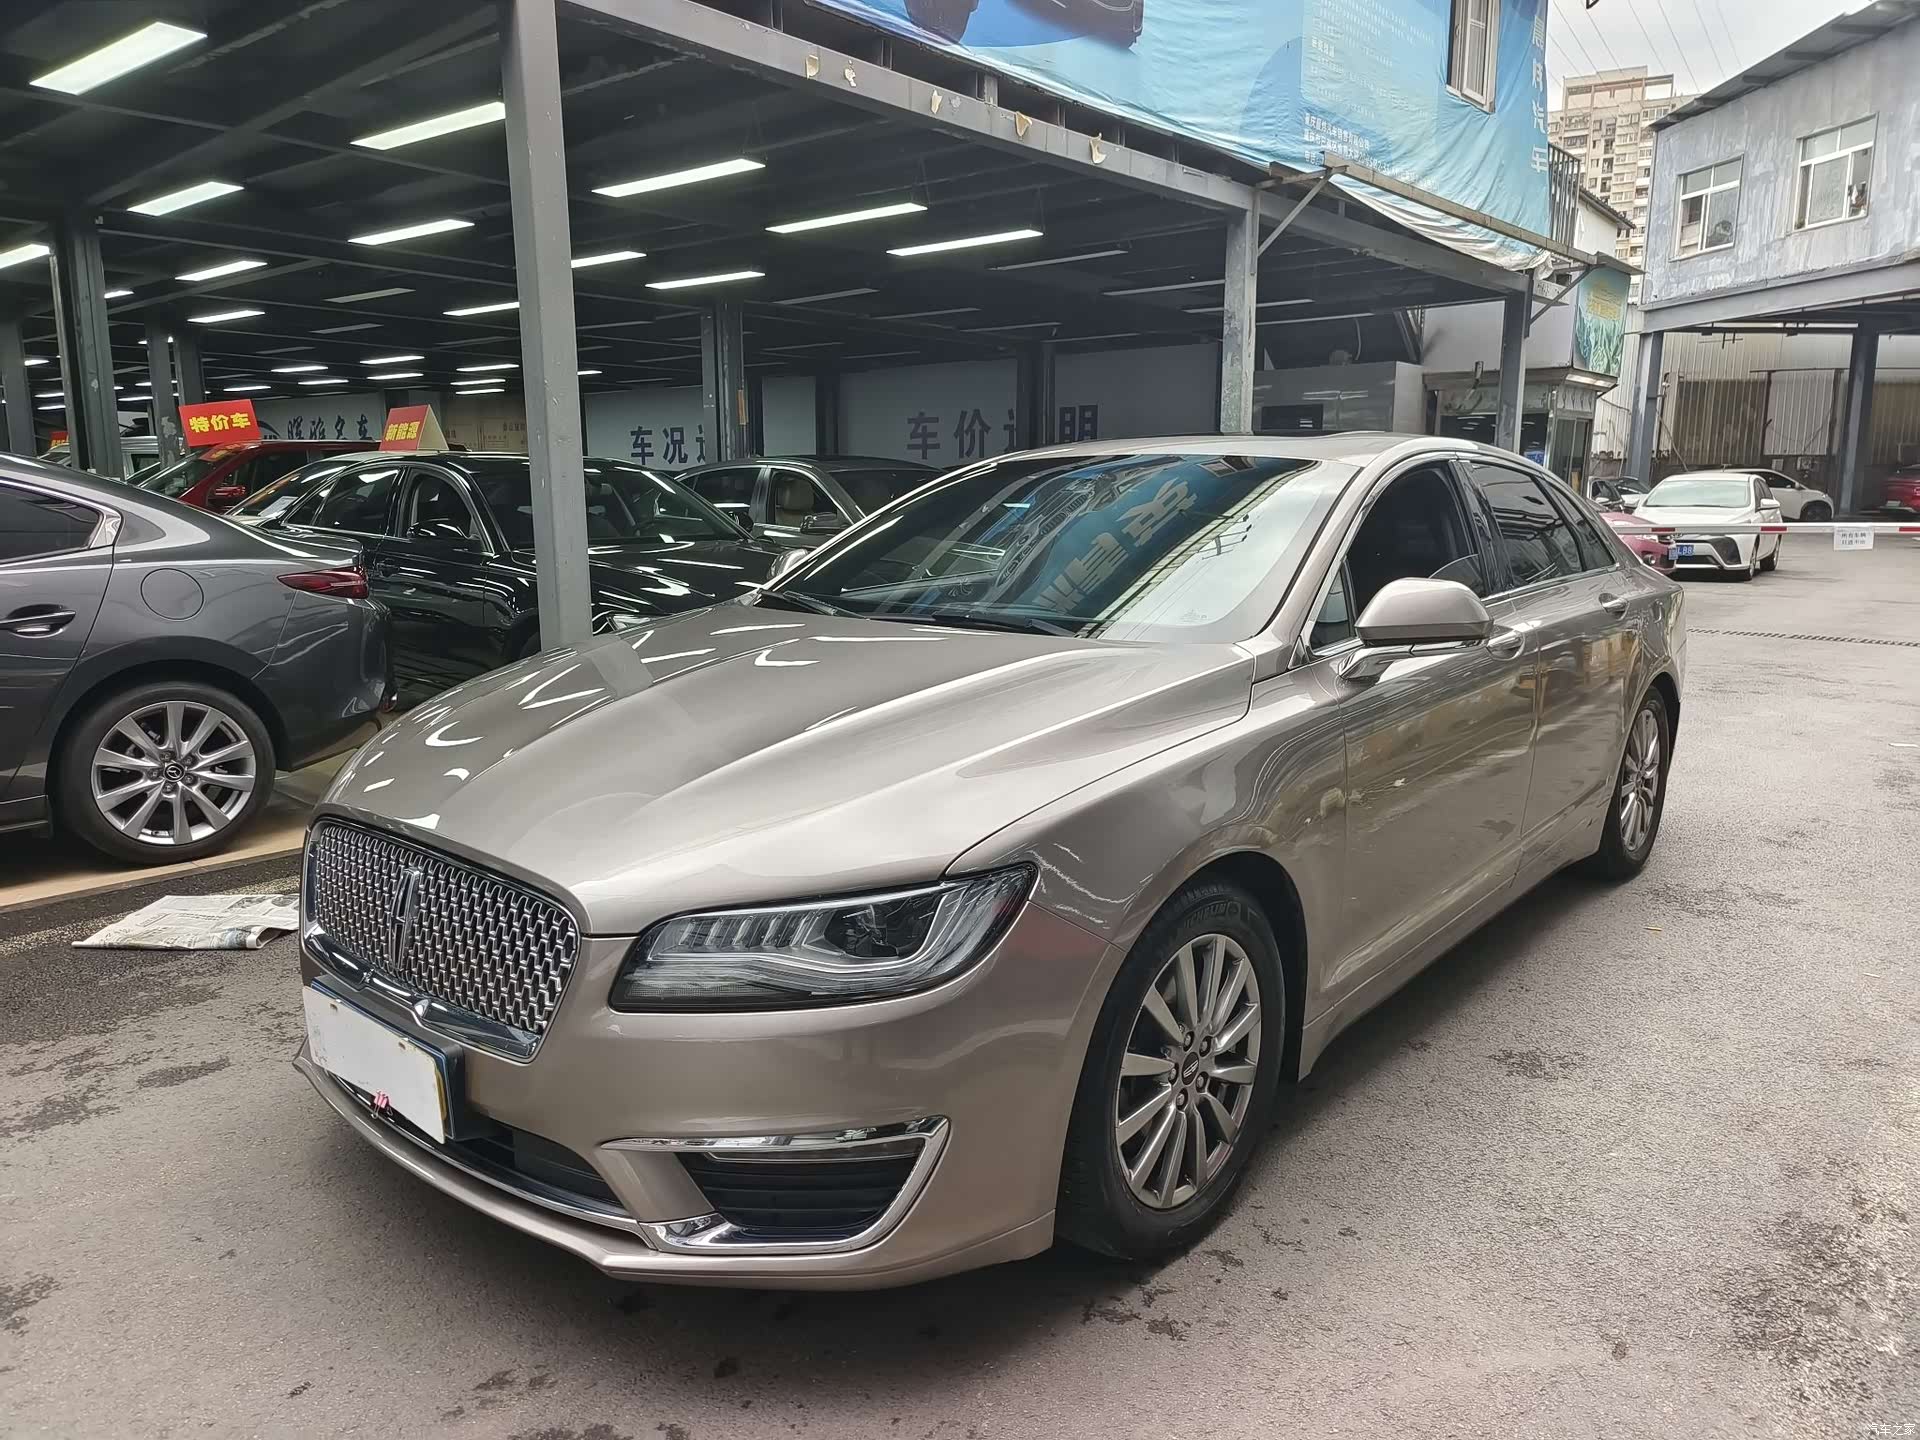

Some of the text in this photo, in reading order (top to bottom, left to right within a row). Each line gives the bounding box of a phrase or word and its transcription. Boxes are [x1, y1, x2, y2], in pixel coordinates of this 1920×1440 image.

[189, 412, 251, 433] 特价车
[385, 421, 420, 441] 新能源
